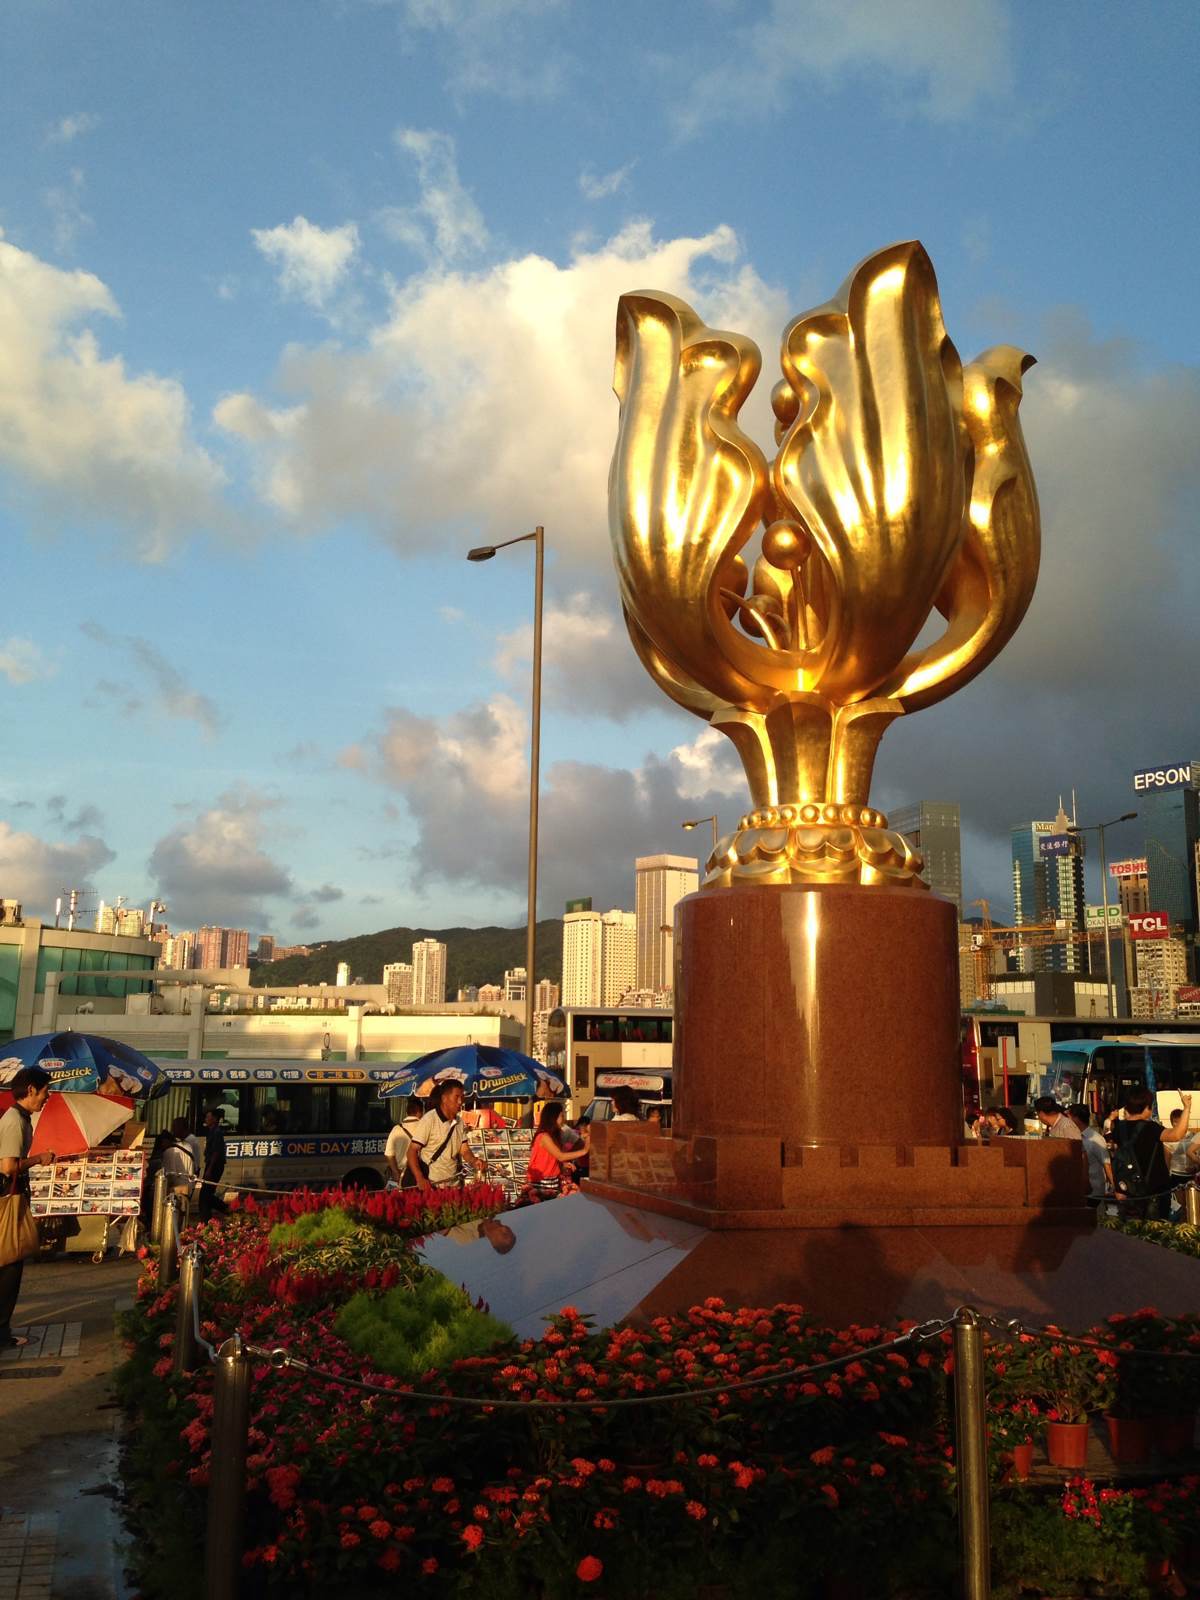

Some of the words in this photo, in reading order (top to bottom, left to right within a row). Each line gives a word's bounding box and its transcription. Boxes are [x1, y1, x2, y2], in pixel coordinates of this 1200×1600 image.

[1134, 766, 1190, 790] EPSON
[1087, 907, 1120, 918] LED
[1129, 917, 1168, 932] TCL
[479, 1072, 529, 1091] Drumstick
[287, 1142, 316, 1155] ONE
[320, 1142, 350, 1154] DAY
